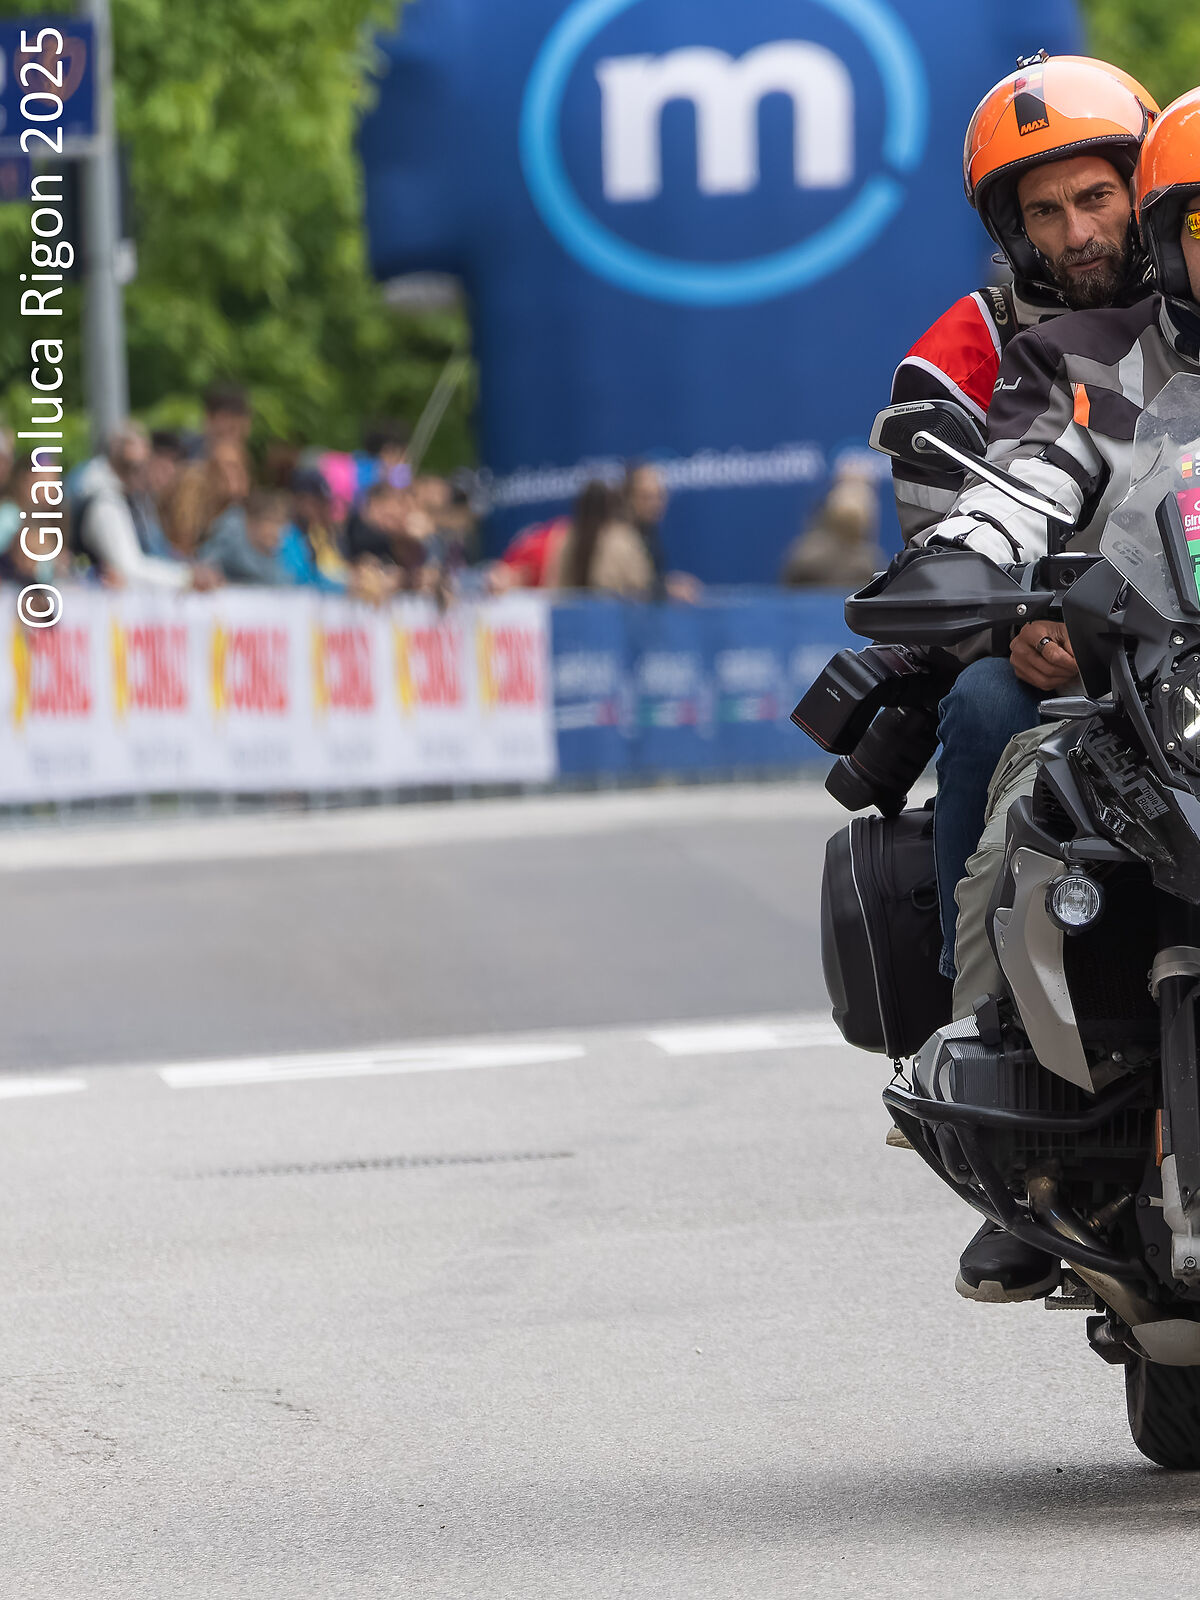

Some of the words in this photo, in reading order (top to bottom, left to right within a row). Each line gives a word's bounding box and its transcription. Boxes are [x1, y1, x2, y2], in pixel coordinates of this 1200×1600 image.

[595, 38, 856, 204] m
[1020, 118, 1049, 136] MAX
[1142, 785, 1158, 805] Triple
[1137, 796, 1156, 818] Black
